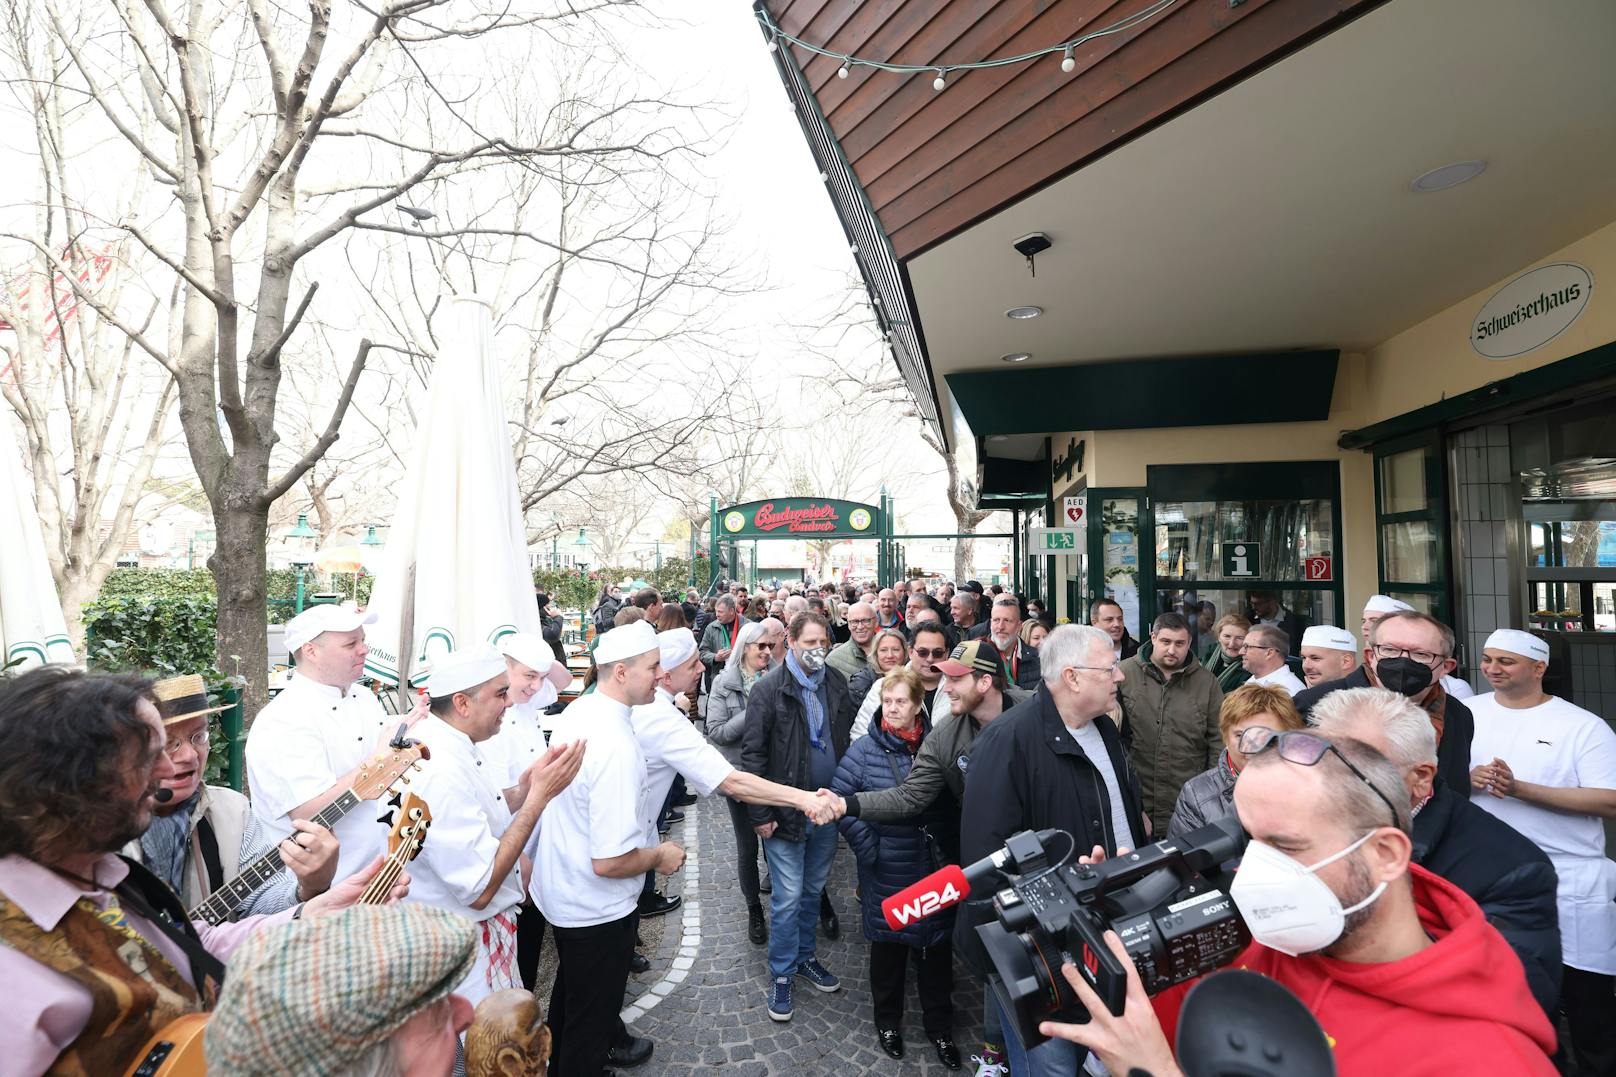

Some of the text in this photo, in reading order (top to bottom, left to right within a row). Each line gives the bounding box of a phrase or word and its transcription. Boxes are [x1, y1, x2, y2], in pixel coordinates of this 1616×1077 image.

[1476, 283, 1581, 341] Schweizerhaus
[1067, 498, 1084, 506] AED
[754, 502, 839, 530] Budweiser
[891, 882, 961, 925] W24
[1202, 900, 1230, 916] SONY
[1120, 927, 1136, 937] 4K
